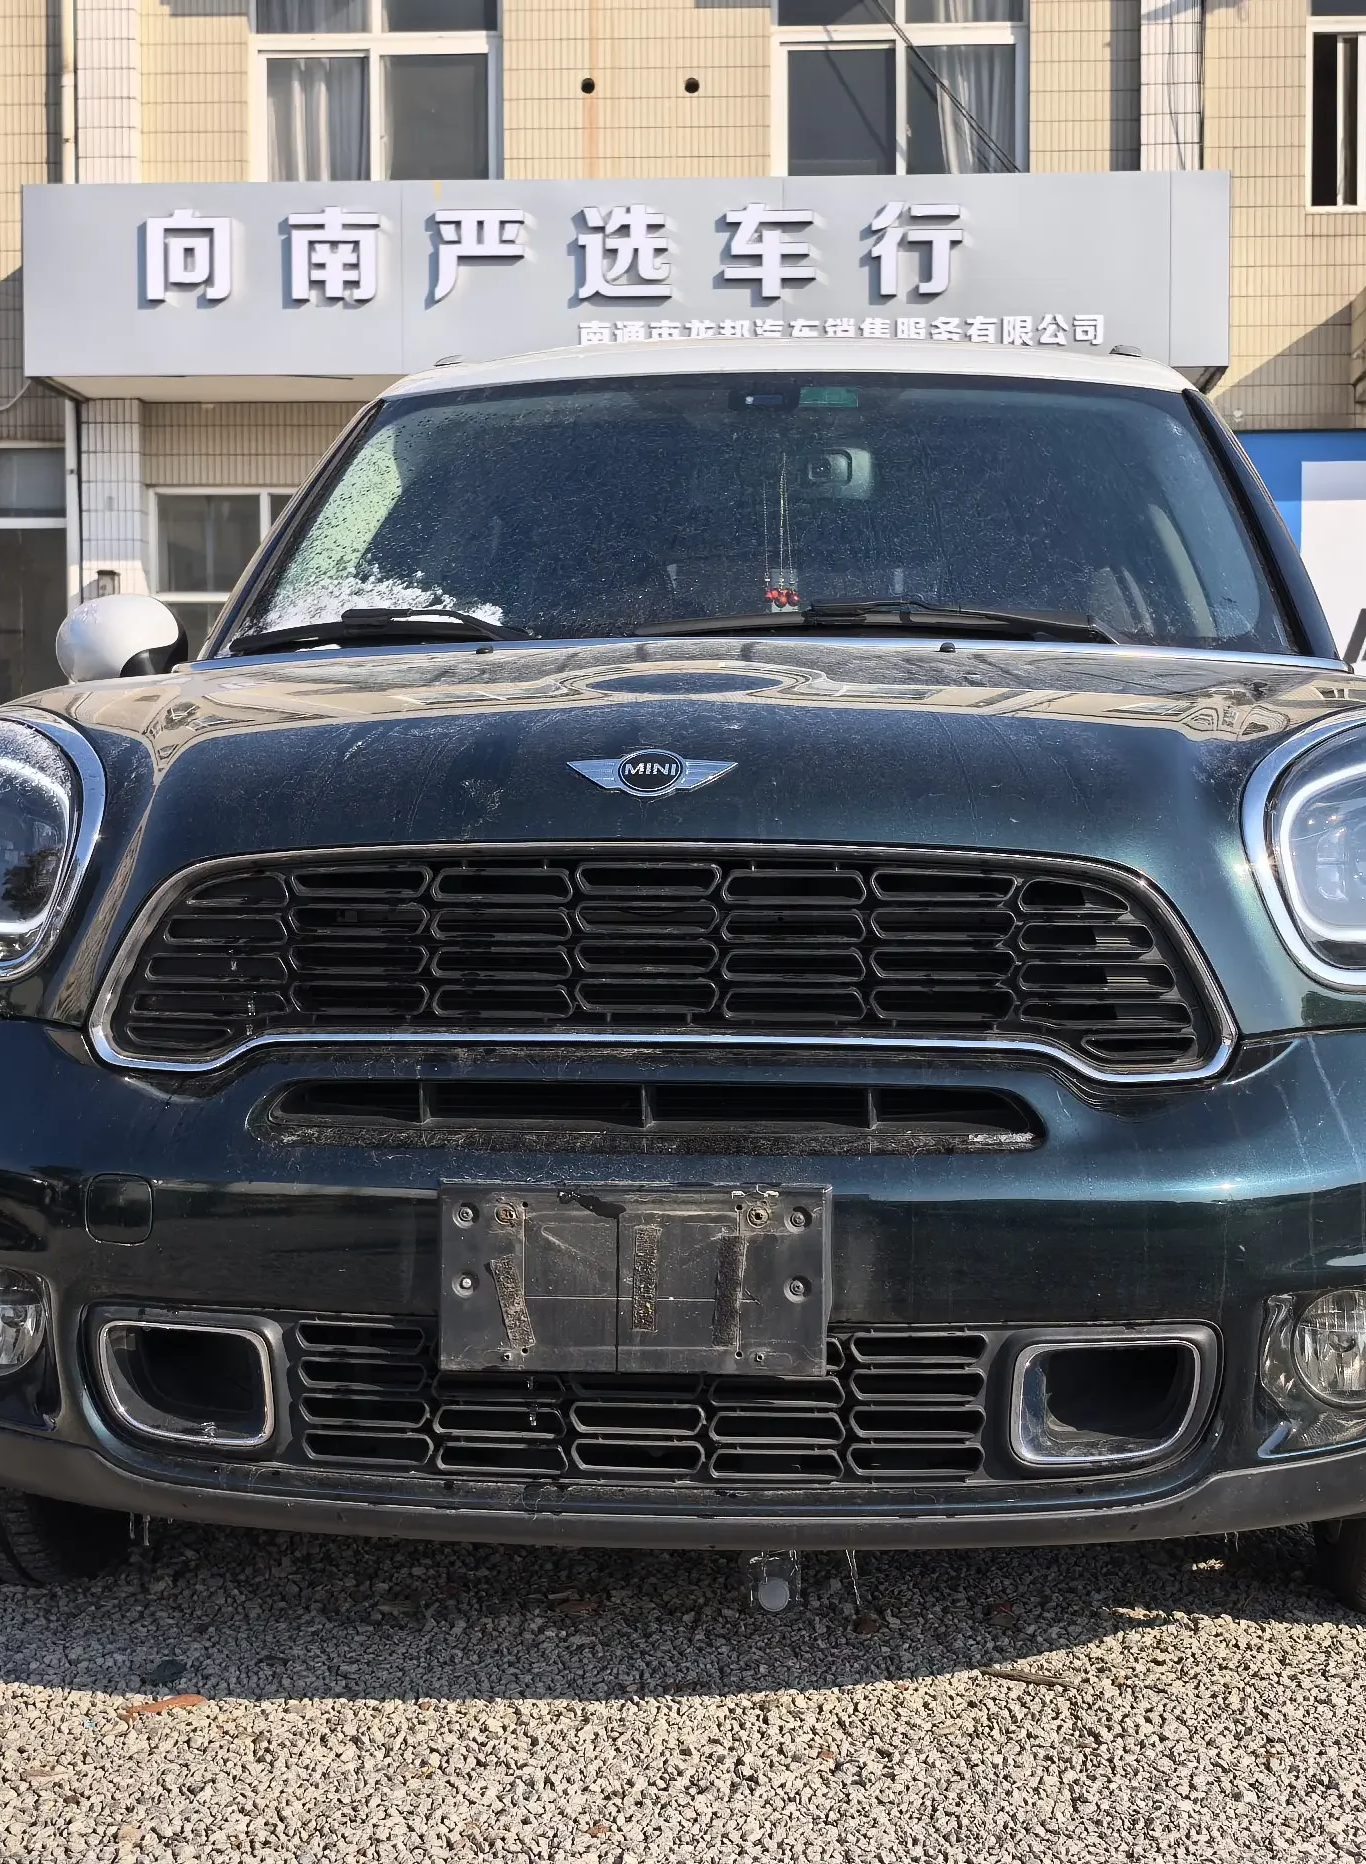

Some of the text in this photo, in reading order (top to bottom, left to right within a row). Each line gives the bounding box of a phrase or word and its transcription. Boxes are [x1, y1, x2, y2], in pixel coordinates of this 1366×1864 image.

[144, 202, 966, 306] 向南严选车行
[625, 762, 677, 776] MINI
